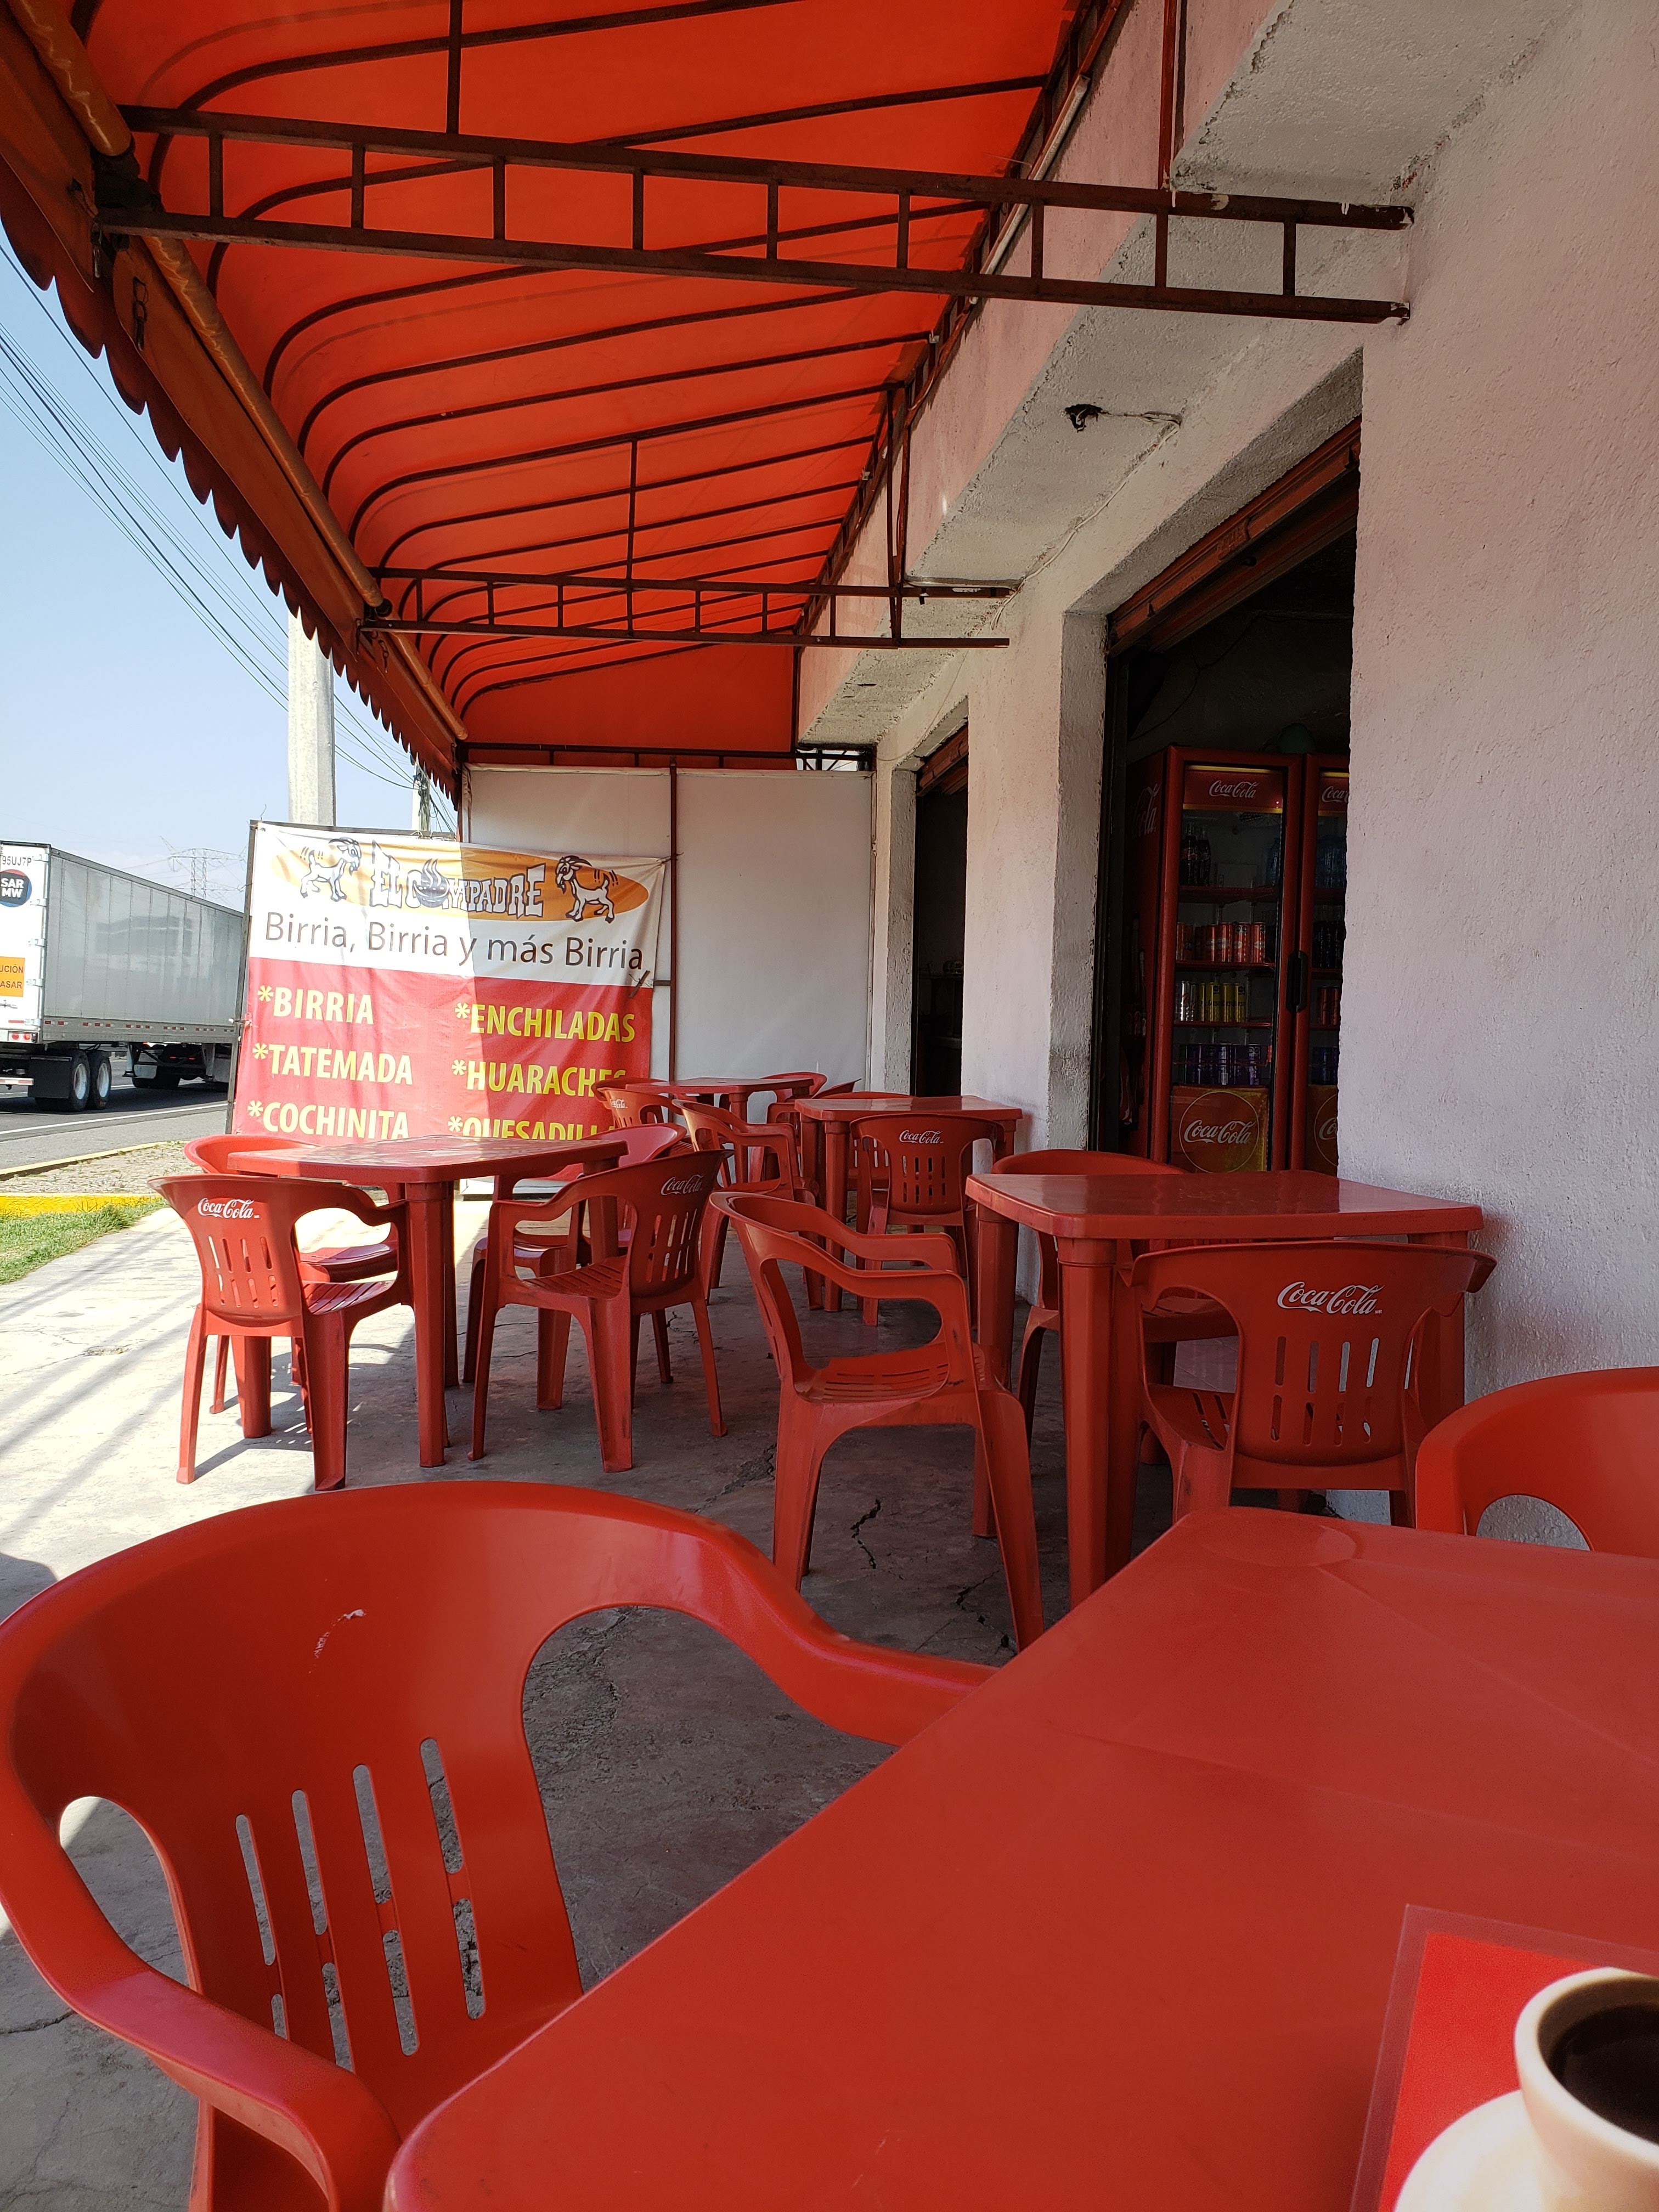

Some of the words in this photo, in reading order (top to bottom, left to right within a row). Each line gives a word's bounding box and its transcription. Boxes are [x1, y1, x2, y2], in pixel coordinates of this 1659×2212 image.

[1209, 780, 1259, 799] Coca-Cola
[2, 856, 32, 866] 95UJ7P
[1, 878, 24, 889] SAR
[2, 888, 23, 898] MW
[266, 912, 356, 953] Birria,
[368, 921, 447, 956] Birria
[459, 936, 477, 966] y
[487, 934, 554, 964] más
[566, 936, 643, 970] Birria
[899, 1130, 943, 1144] Coca-Cola
[1184, 1120, 1256, 1144] Coca-Cola
[661, 1175, 703, 1196] Coca-Cola
[198, 1198, 255, 1218] Coca-Cola
[1277, 1281, 1385, 1314] Coca-Cola
